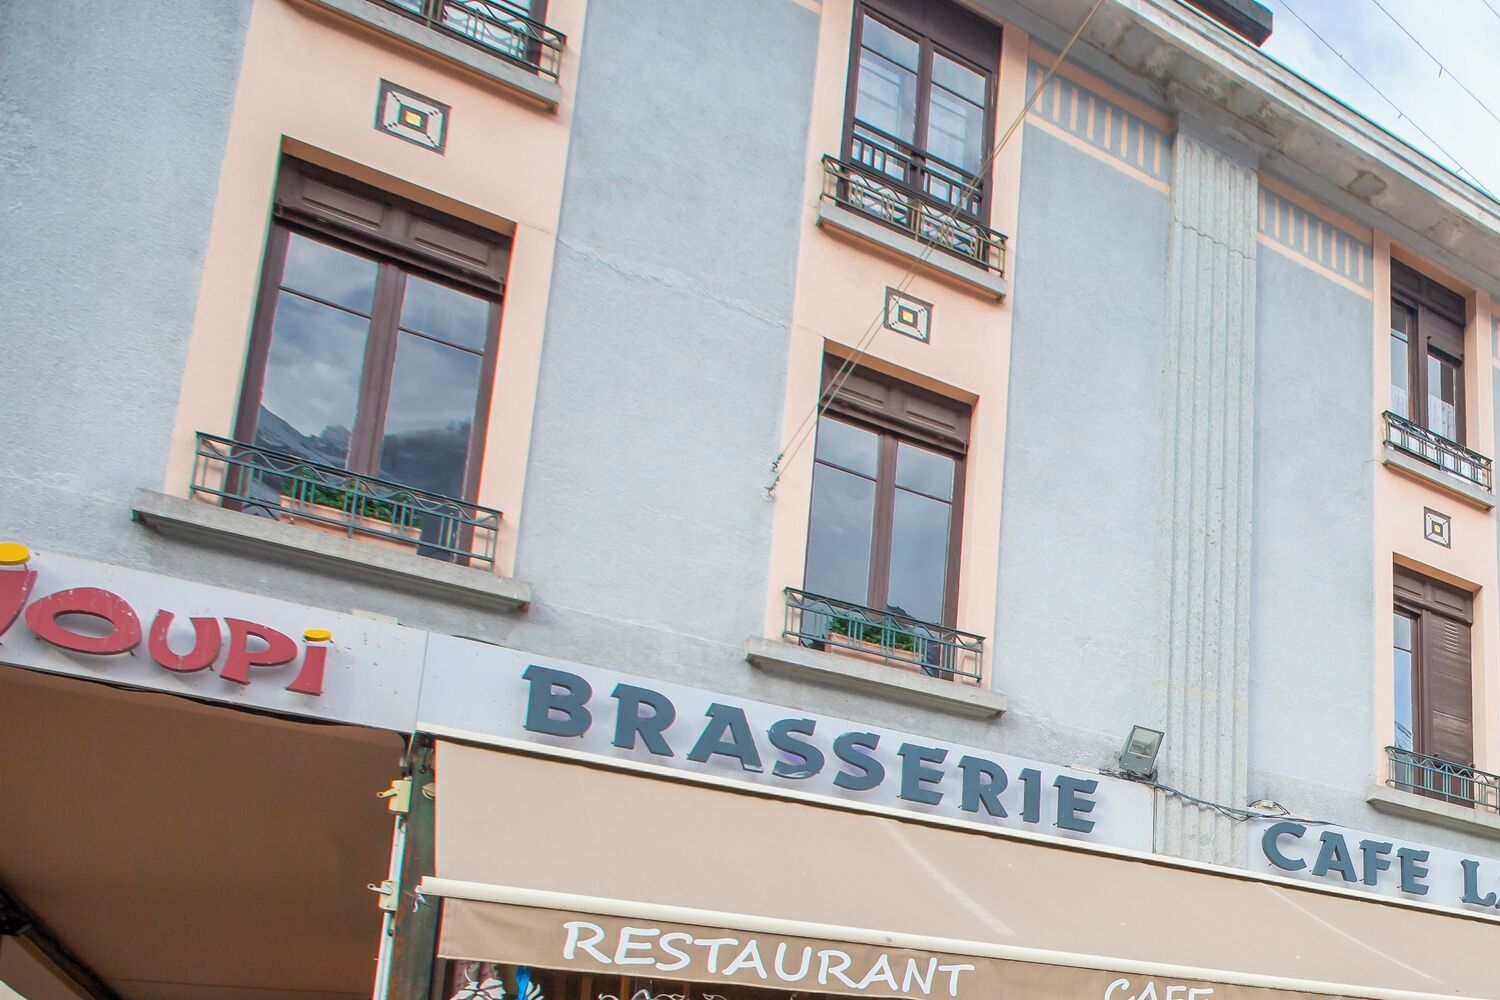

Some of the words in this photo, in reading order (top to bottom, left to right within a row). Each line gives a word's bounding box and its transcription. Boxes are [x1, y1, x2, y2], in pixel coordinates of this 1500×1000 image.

[522, 664, 1099, 834] BRASSERIE
[1261, 821, 1429, 895] CAFE
[562, 920, 975, 998] RESTAURANT
